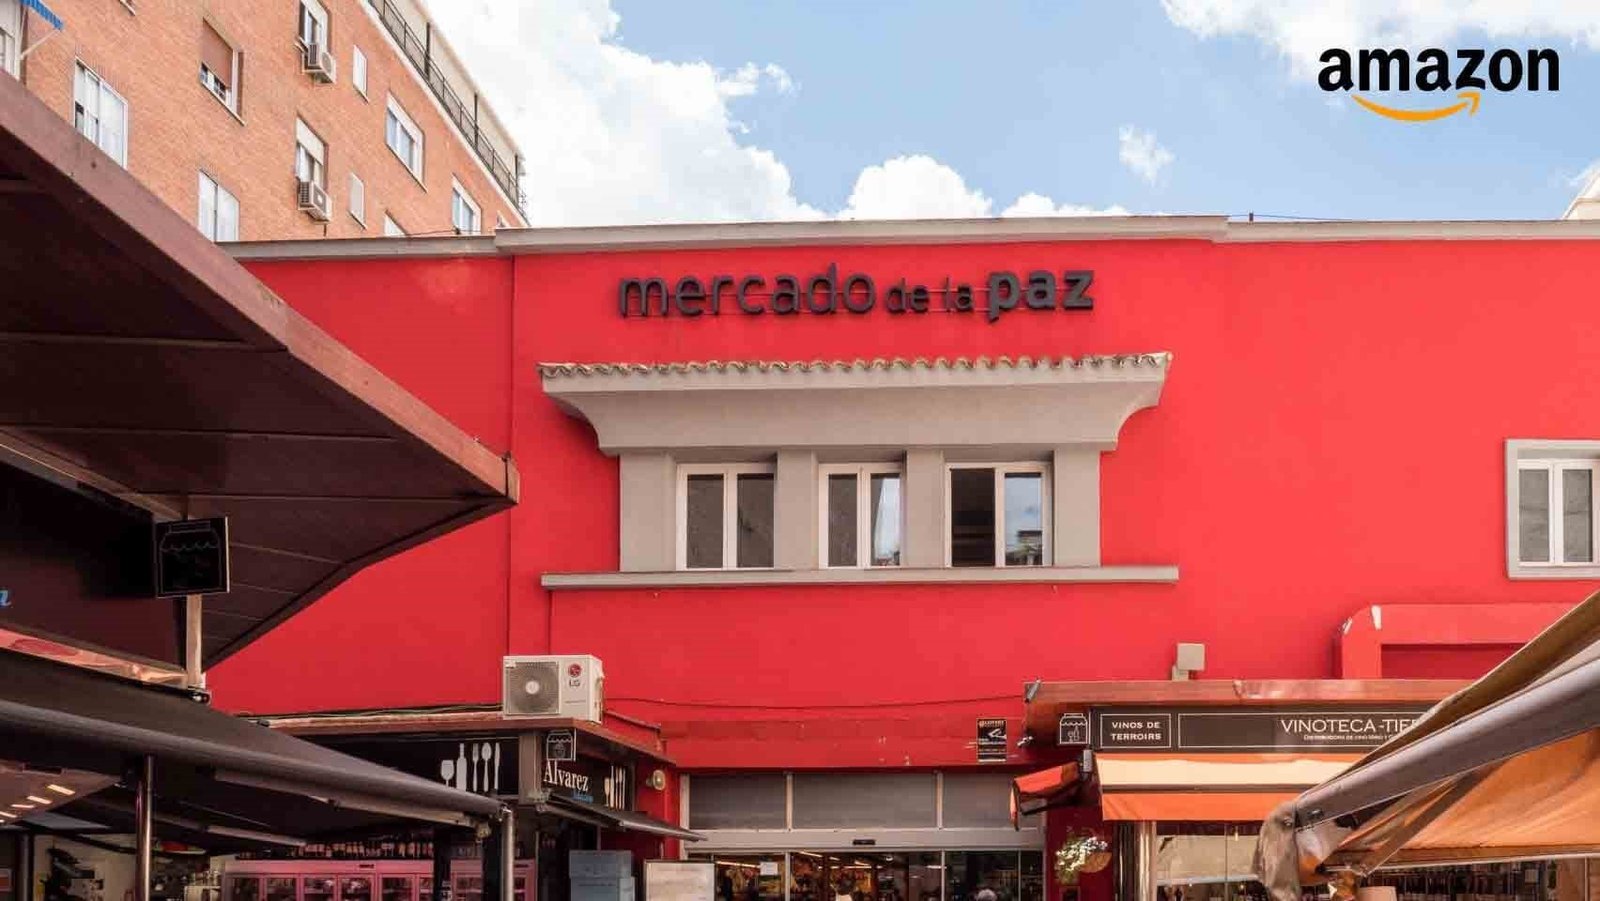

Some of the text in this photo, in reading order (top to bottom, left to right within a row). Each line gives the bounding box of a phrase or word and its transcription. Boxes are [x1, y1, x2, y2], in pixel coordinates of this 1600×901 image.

[619, 262, 1094, 323] mercado de la paz
[1111, 721, 1161, 729] VINOS DE
[1111, 733, 1162, 741] TERROIRS
